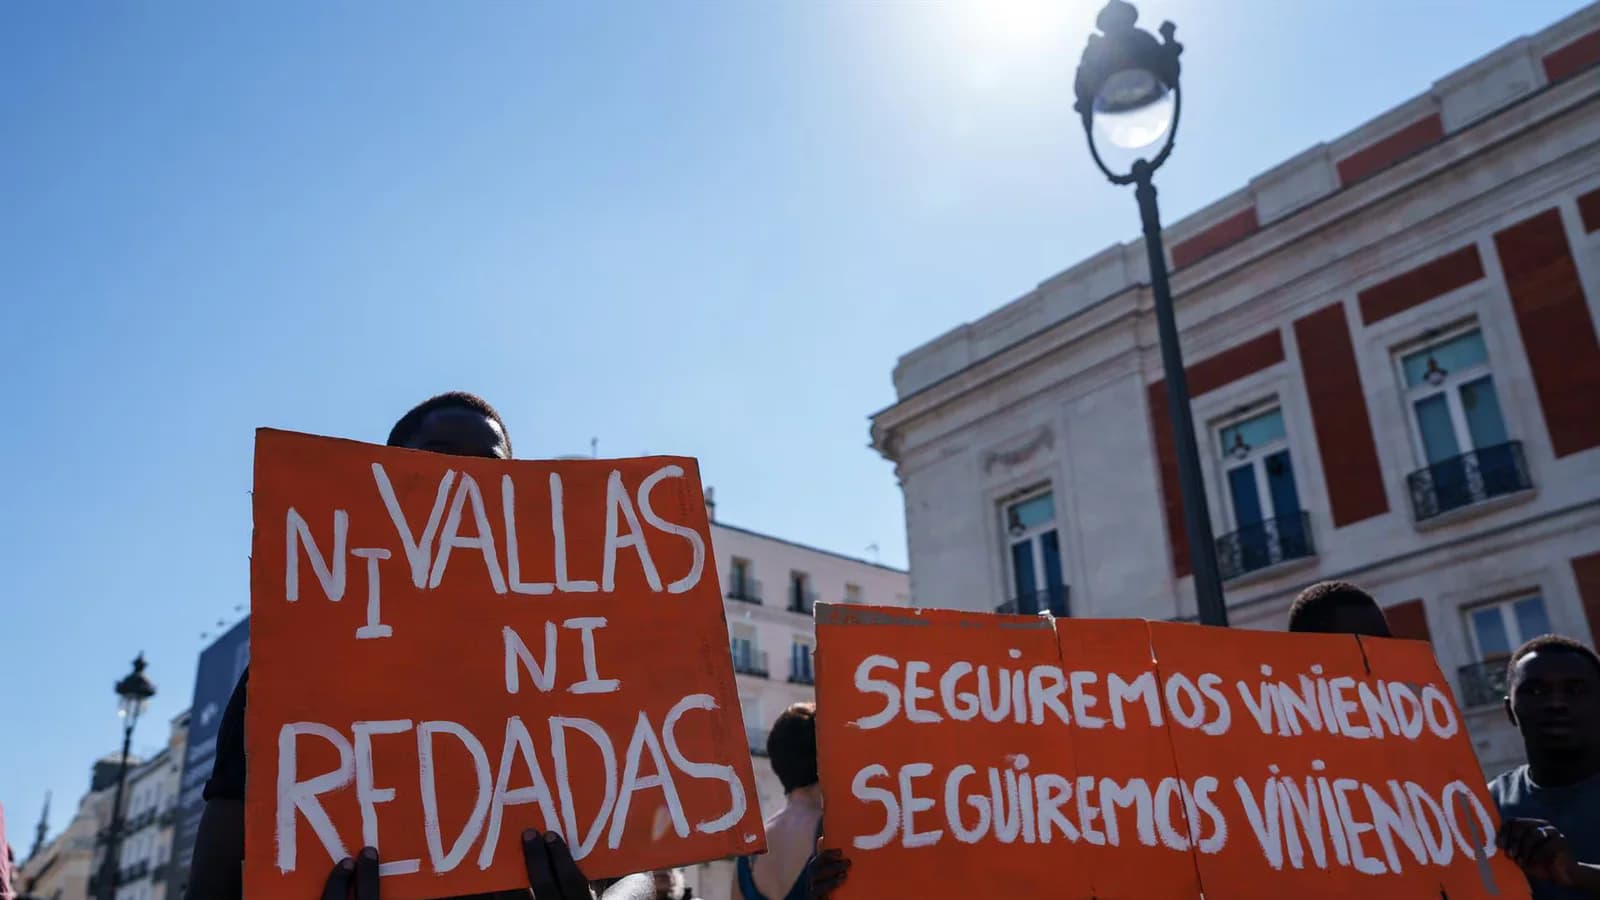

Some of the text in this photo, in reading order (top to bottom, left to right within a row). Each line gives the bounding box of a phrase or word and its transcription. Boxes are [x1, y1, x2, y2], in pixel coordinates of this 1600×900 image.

[286, 463, 706, 638] NI VALLAS
[503, 616, 621, 694] NI
[277, 694, 747, 876] REDADAS
